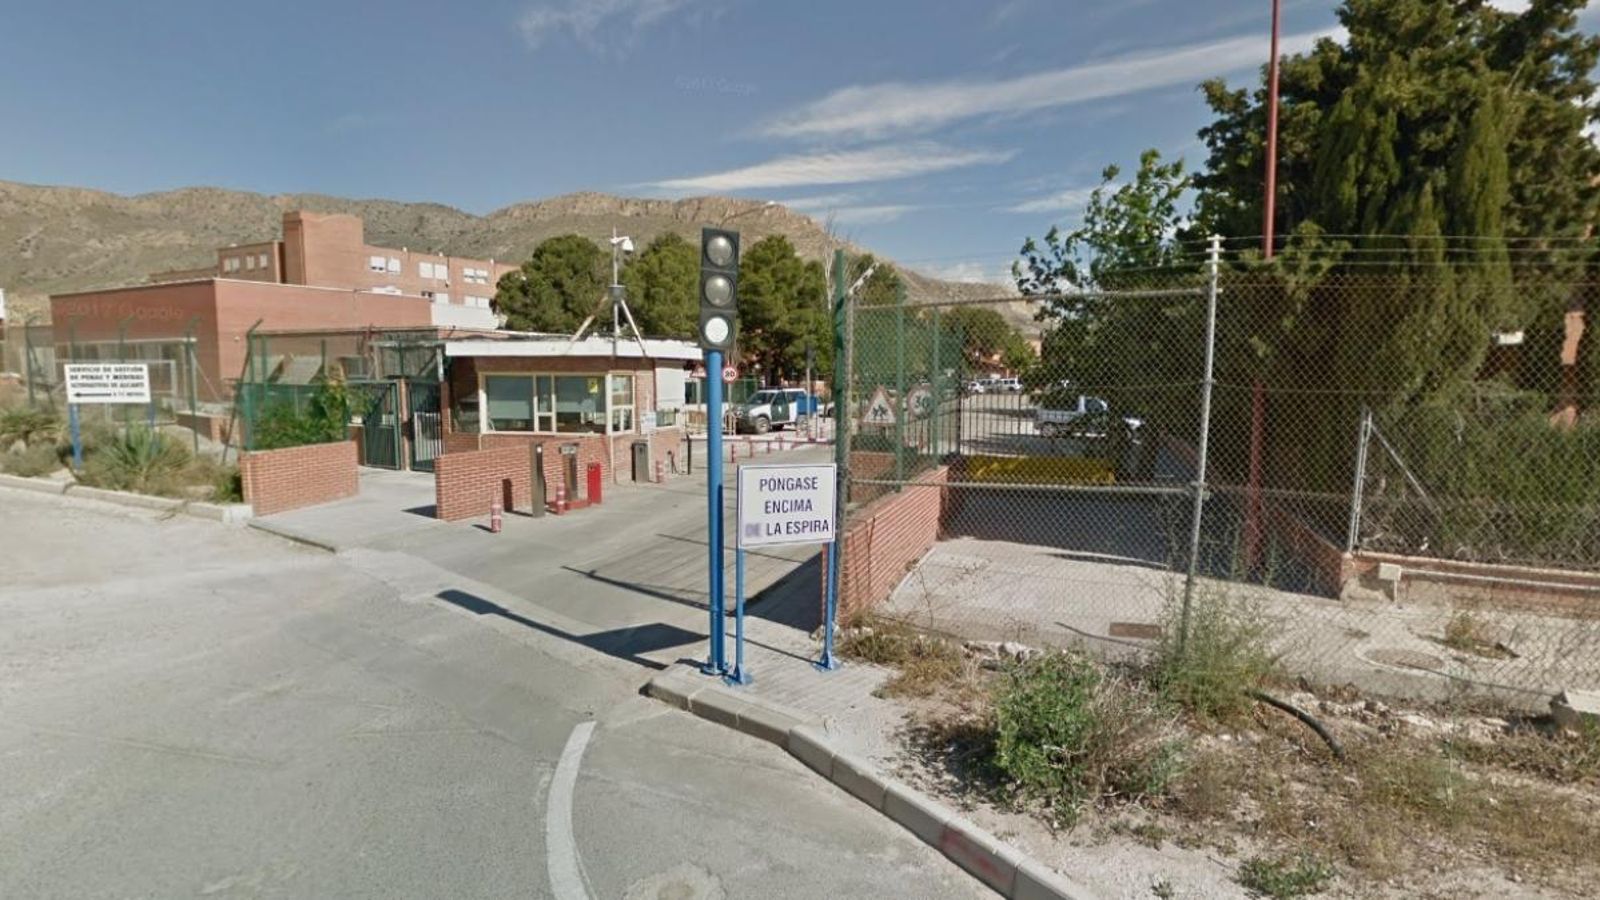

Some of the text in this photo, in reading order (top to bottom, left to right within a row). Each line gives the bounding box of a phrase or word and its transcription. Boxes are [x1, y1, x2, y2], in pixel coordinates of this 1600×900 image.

[764, 499, 813, 515] ENCIMA
[766, 522, 782, 537] LA
[785, 519, 829, 536] ESPIRA
